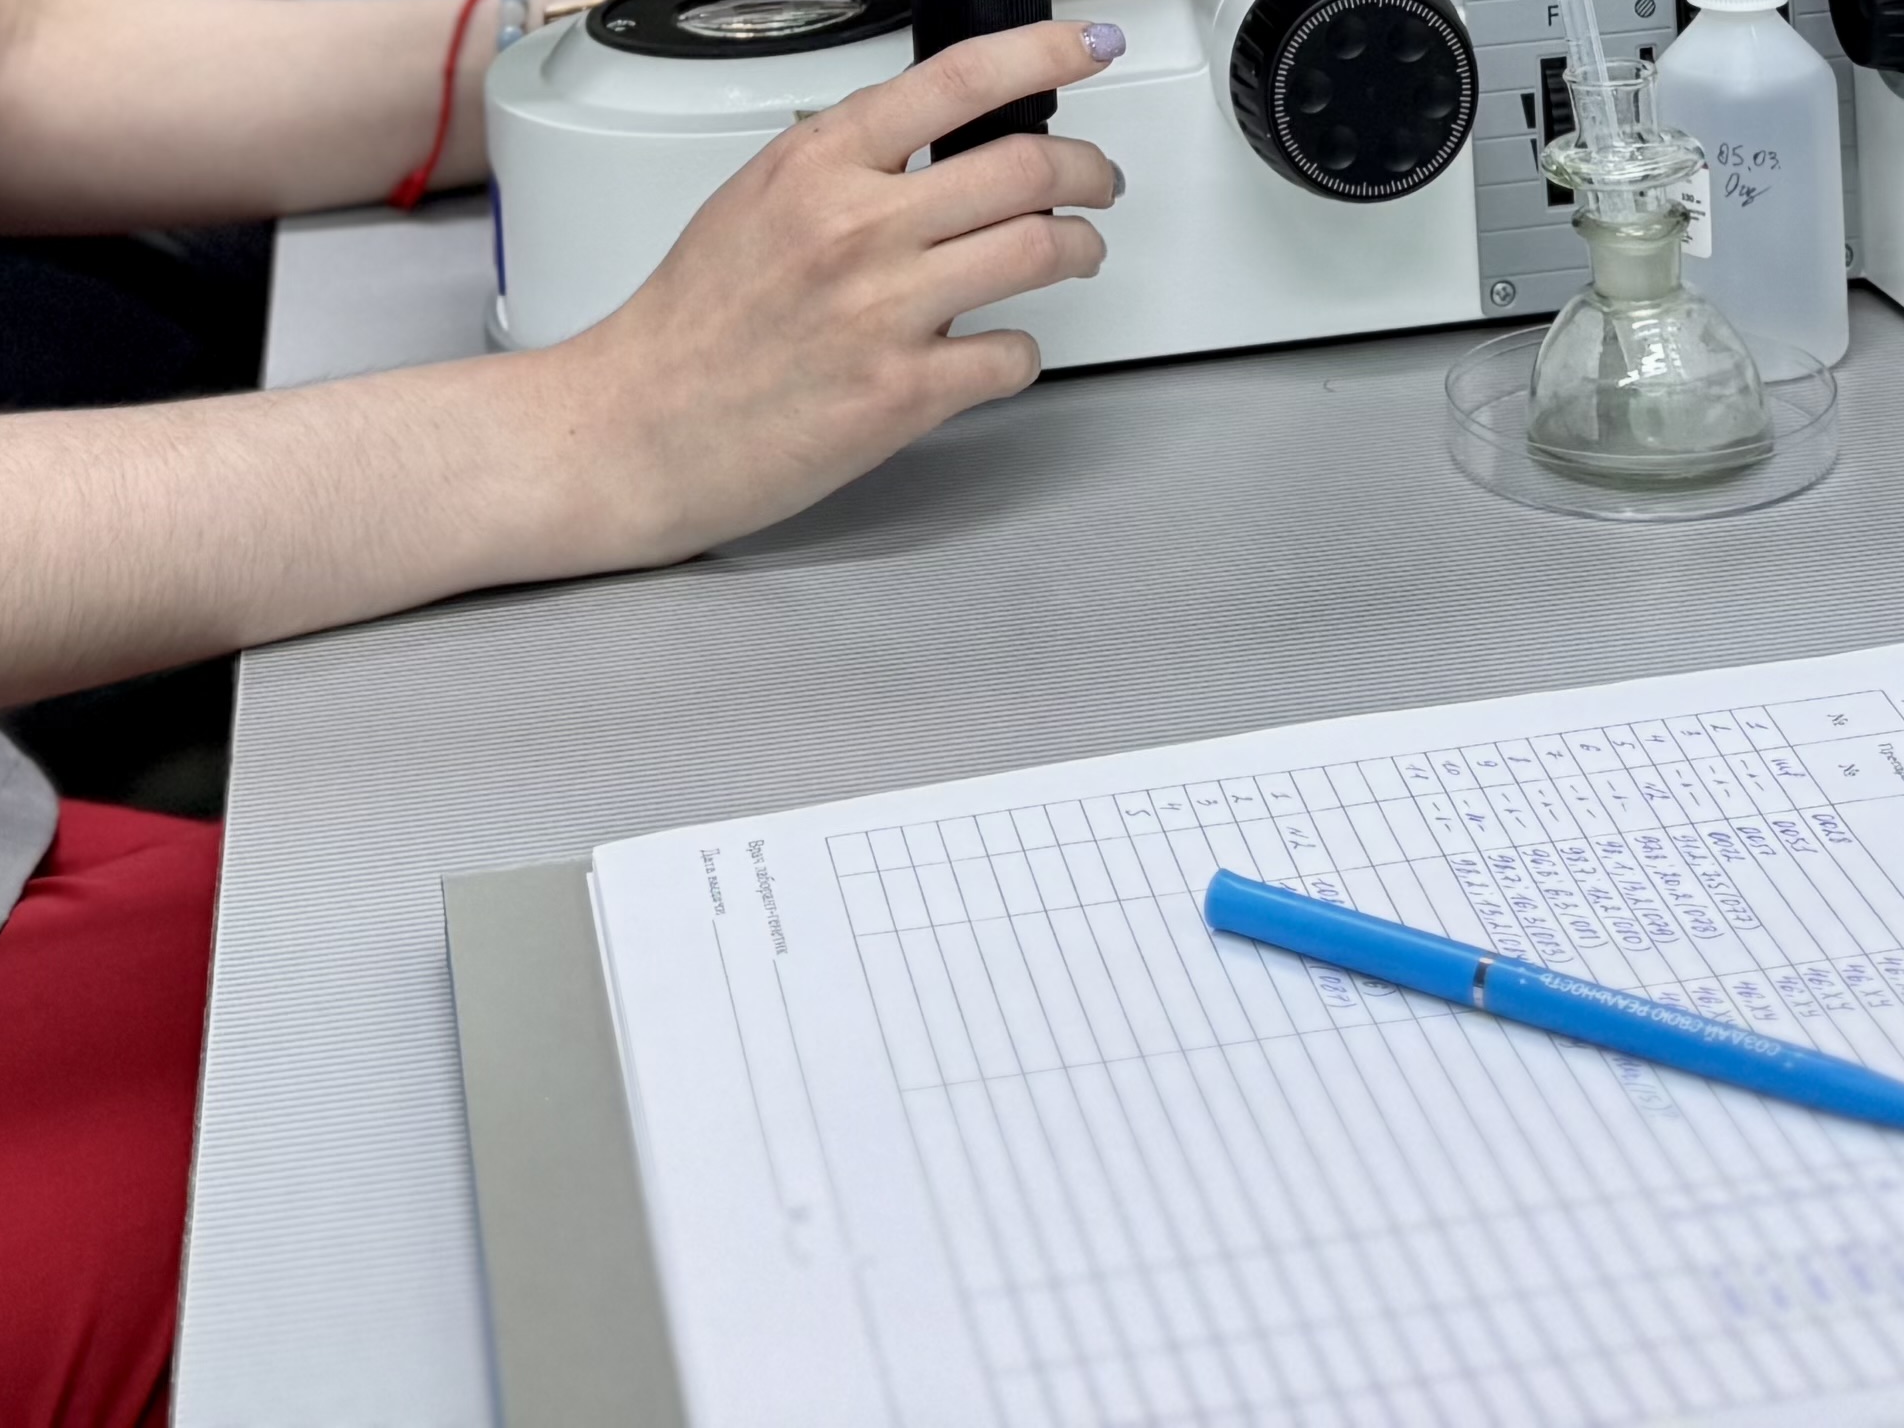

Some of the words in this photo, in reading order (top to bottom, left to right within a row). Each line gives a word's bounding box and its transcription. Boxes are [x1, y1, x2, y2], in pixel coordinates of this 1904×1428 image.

[1547, 4, 1560, 27] F
[1827, 713, 1849, 727] №
[1837, 763, 1860, 778] №
[699, 847, 721, 874] Дата
[745, 839, 765, 864] Врач
[755, 866, 788, 956] лаборант-генетик
[1538, 973, 1647, 1018] РЕАЛЬНОСТЬ
[1651, 1007, 1705, 1033] СВОЮ
[1704, 1024, 1782, 1056] СОЗДАЙ
